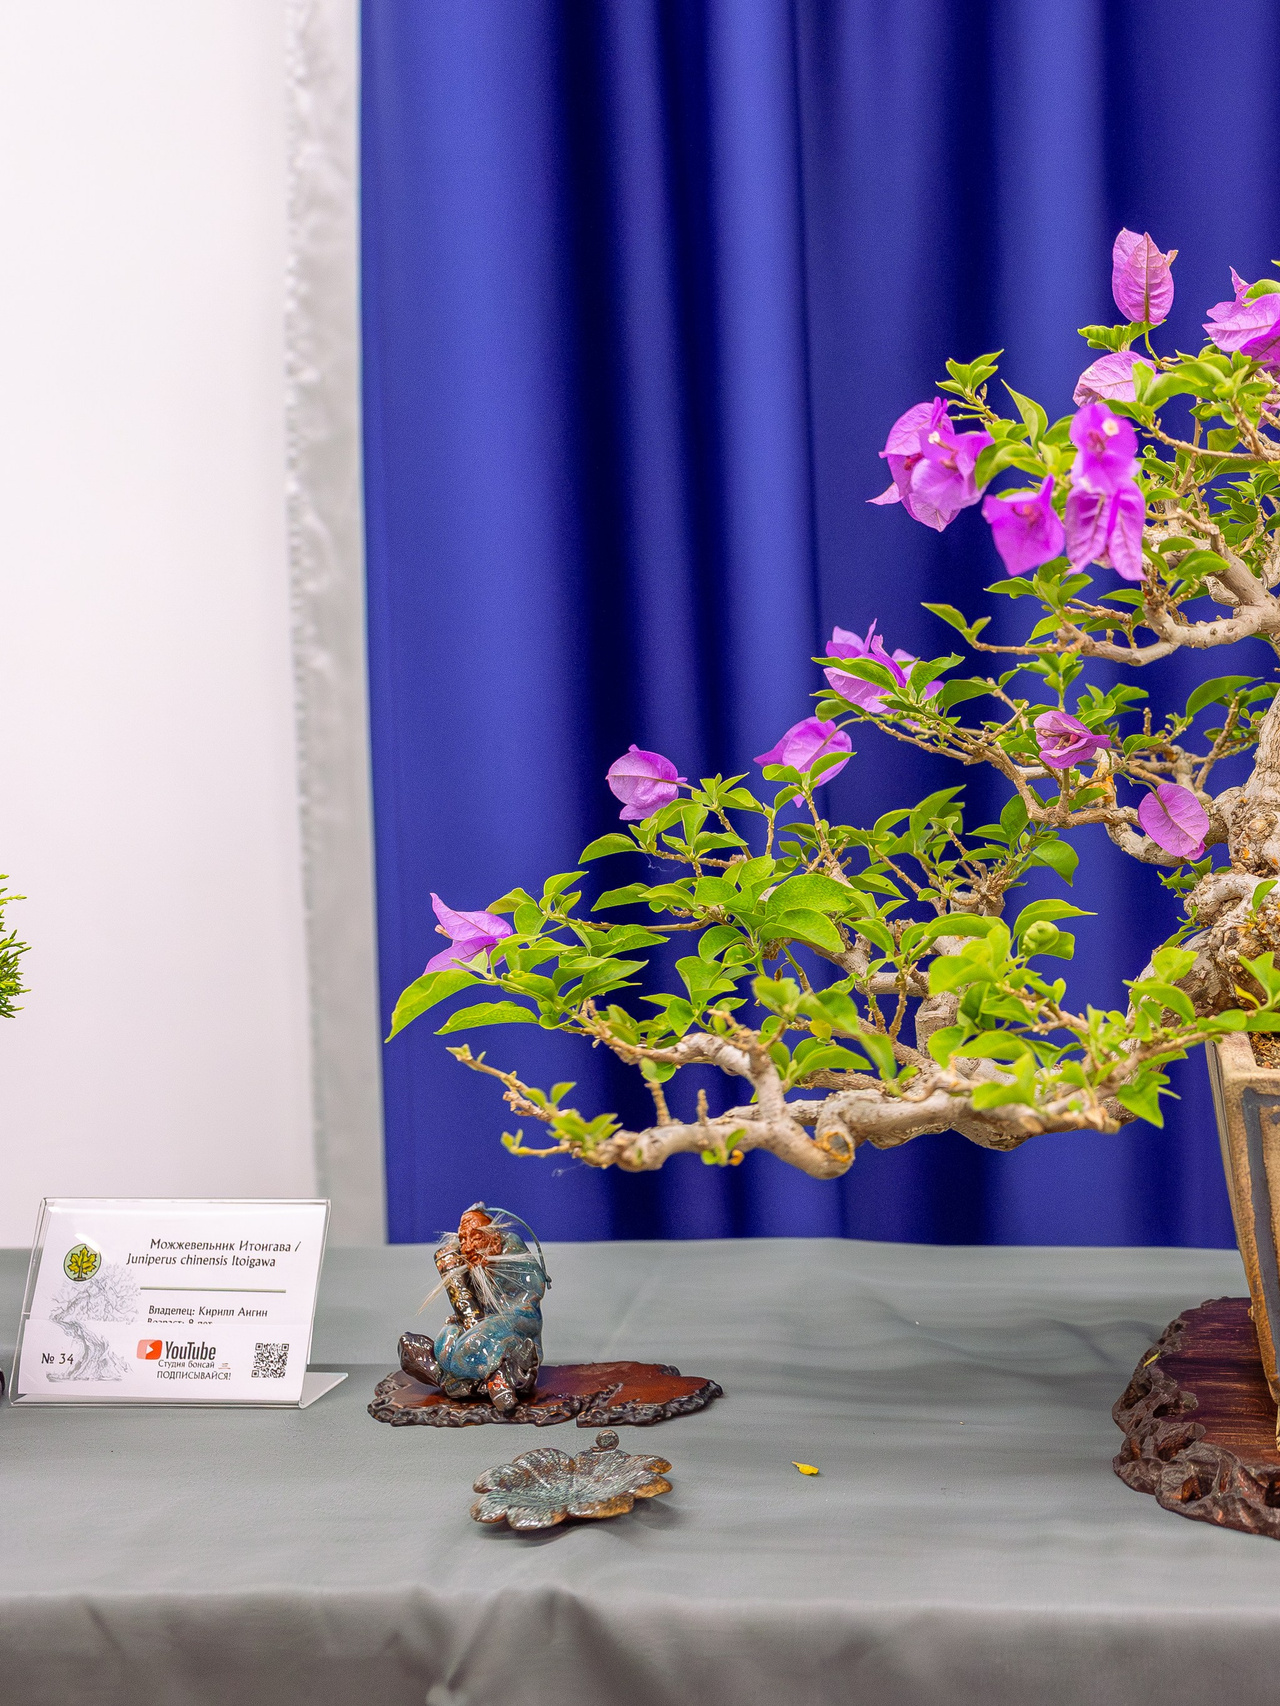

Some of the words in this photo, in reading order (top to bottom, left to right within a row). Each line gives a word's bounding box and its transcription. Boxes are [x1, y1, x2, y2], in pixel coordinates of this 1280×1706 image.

[150, 1238, 235, 1251] Можжевельник
[126, 1252, 177, 1266] Juniperus
[180, 1253, 228, 1266] chinensis
[231, 1255, 276, 1268] Itoigawa
[148, 1304, 196, 1317] Владелец:
[198, 1306, 235, 1318] Кирилл
[164, 1340, 217, 1361] YouTube
[58, 1353, 74, 1365] 34
[157, 1359, 186, 1369] Студия
[188, 1359, 215, 1369] бонсай
[156, 1370, 231, 1381] ПОДПИСЫВАЙСЯ!
